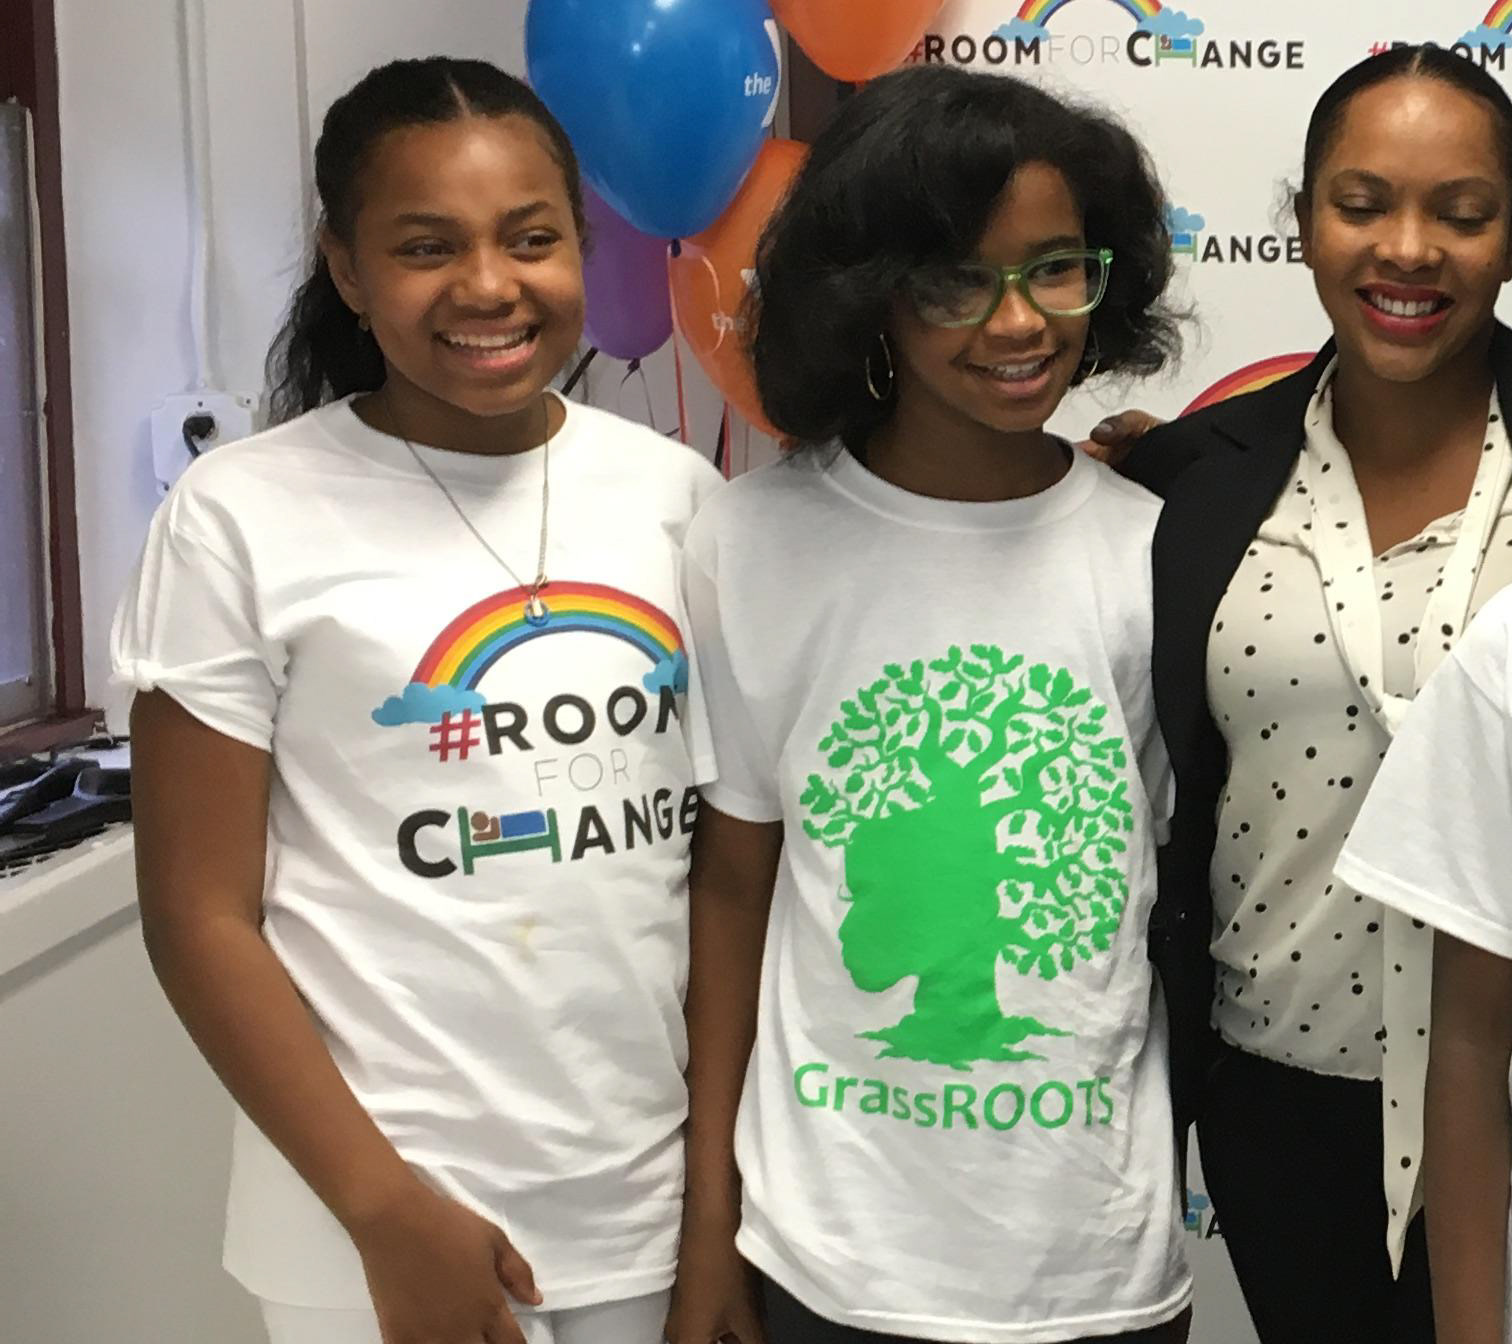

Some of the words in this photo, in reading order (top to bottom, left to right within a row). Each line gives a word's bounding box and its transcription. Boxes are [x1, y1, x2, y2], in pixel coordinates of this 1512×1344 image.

[744, 72, 771, 96] the
[534, 748, 631, 797] FOR
[793, 1062, 1115, 1132] GrassROOTS
